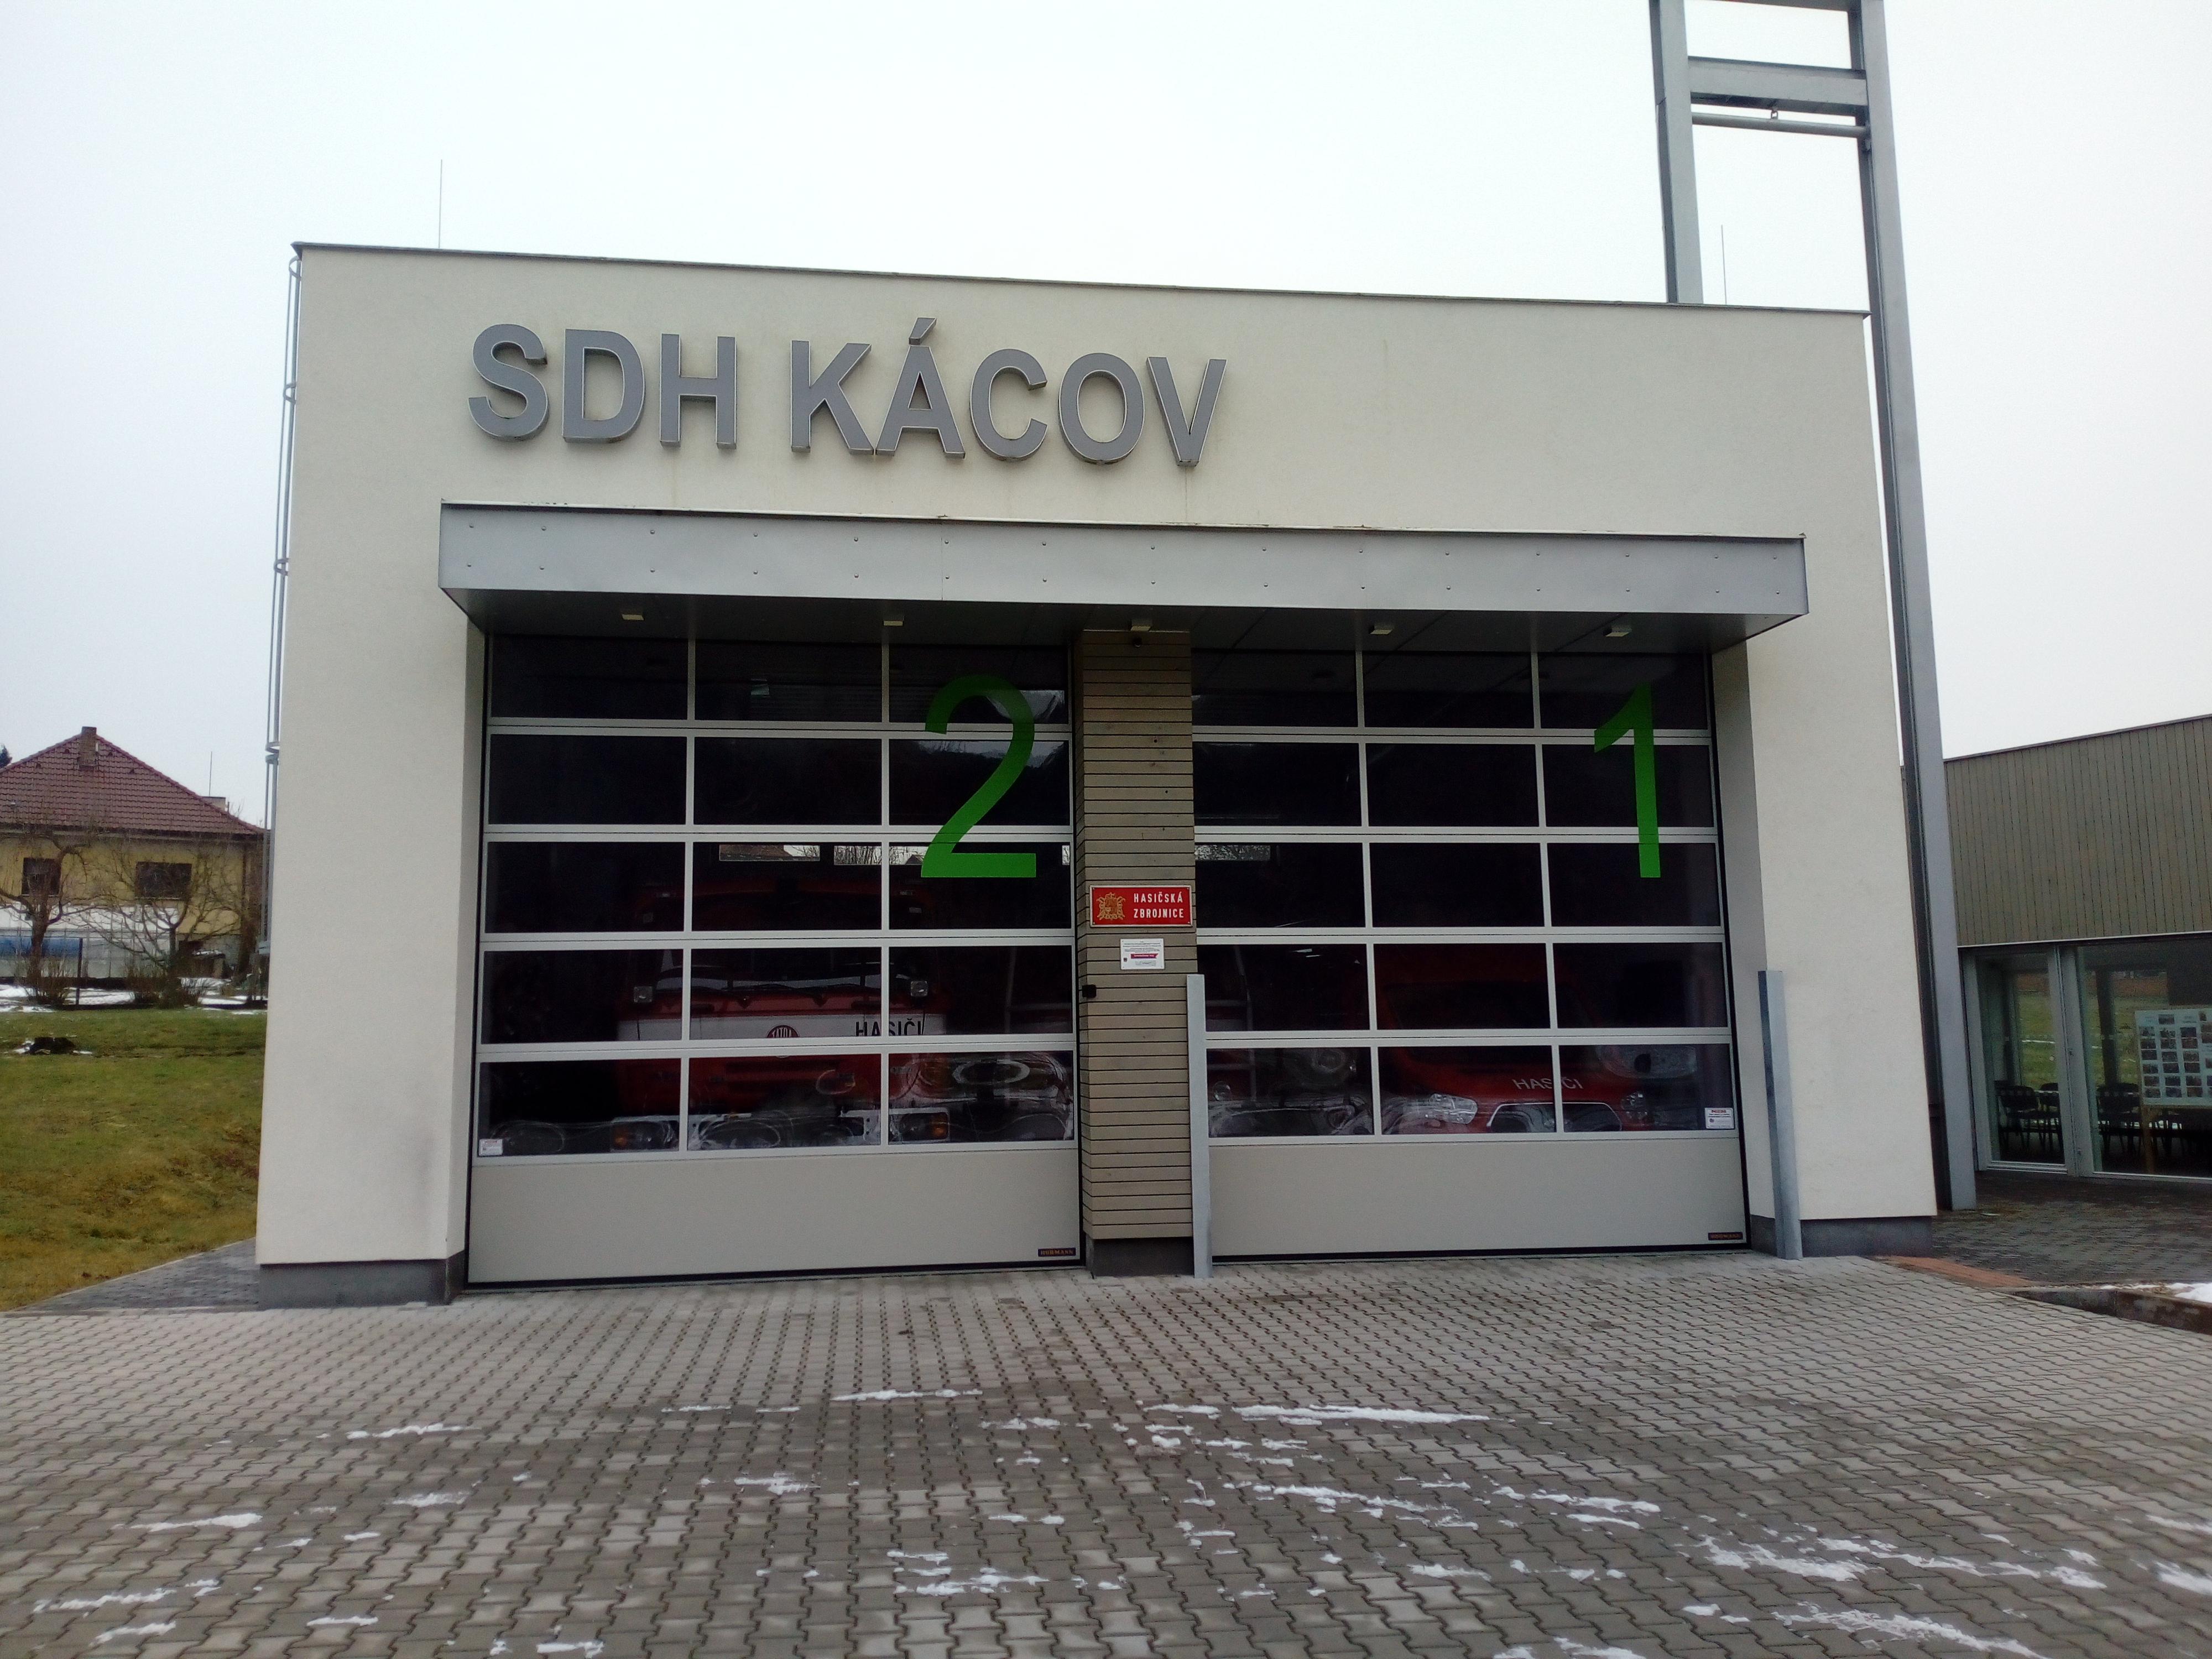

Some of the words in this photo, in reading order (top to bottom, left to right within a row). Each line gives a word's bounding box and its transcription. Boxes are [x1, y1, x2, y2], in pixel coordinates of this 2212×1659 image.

[468, 322, 737, 450] SDH
[790, 317, 1227, 467] KÁCOV
[920, 674, 1036, 878] 2
[1593, 682, 1661, 878] 1
[1134, 891, 1183, 903] HASIČSKÁ
[1134, 908, 1185, 919] ZBROJNICE
[1511, 1076, 1584, 1089] HASČI
